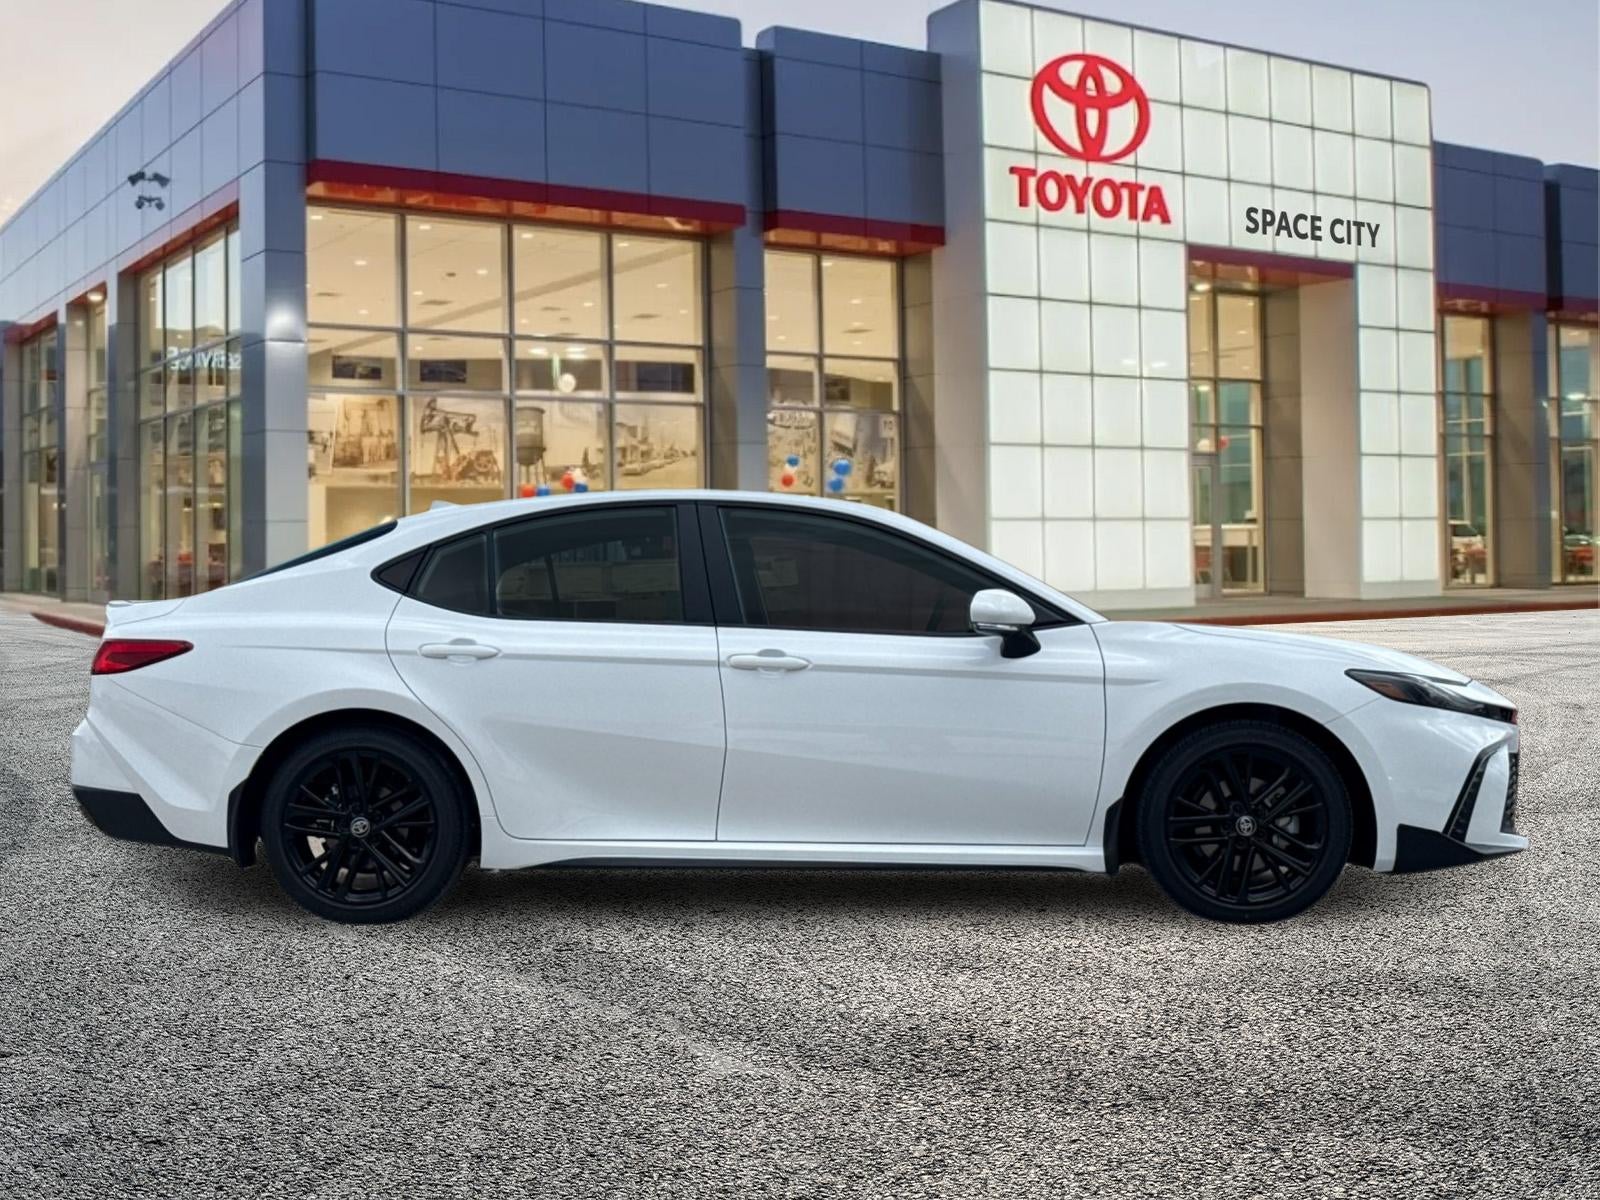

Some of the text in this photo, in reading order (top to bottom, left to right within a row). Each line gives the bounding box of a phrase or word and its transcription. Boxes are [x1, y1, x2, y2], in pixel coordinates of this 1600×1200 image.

[1009, 166, 1171, 224] TOYOTA
[1245, 207, 1380, 248] SPACE CITY
